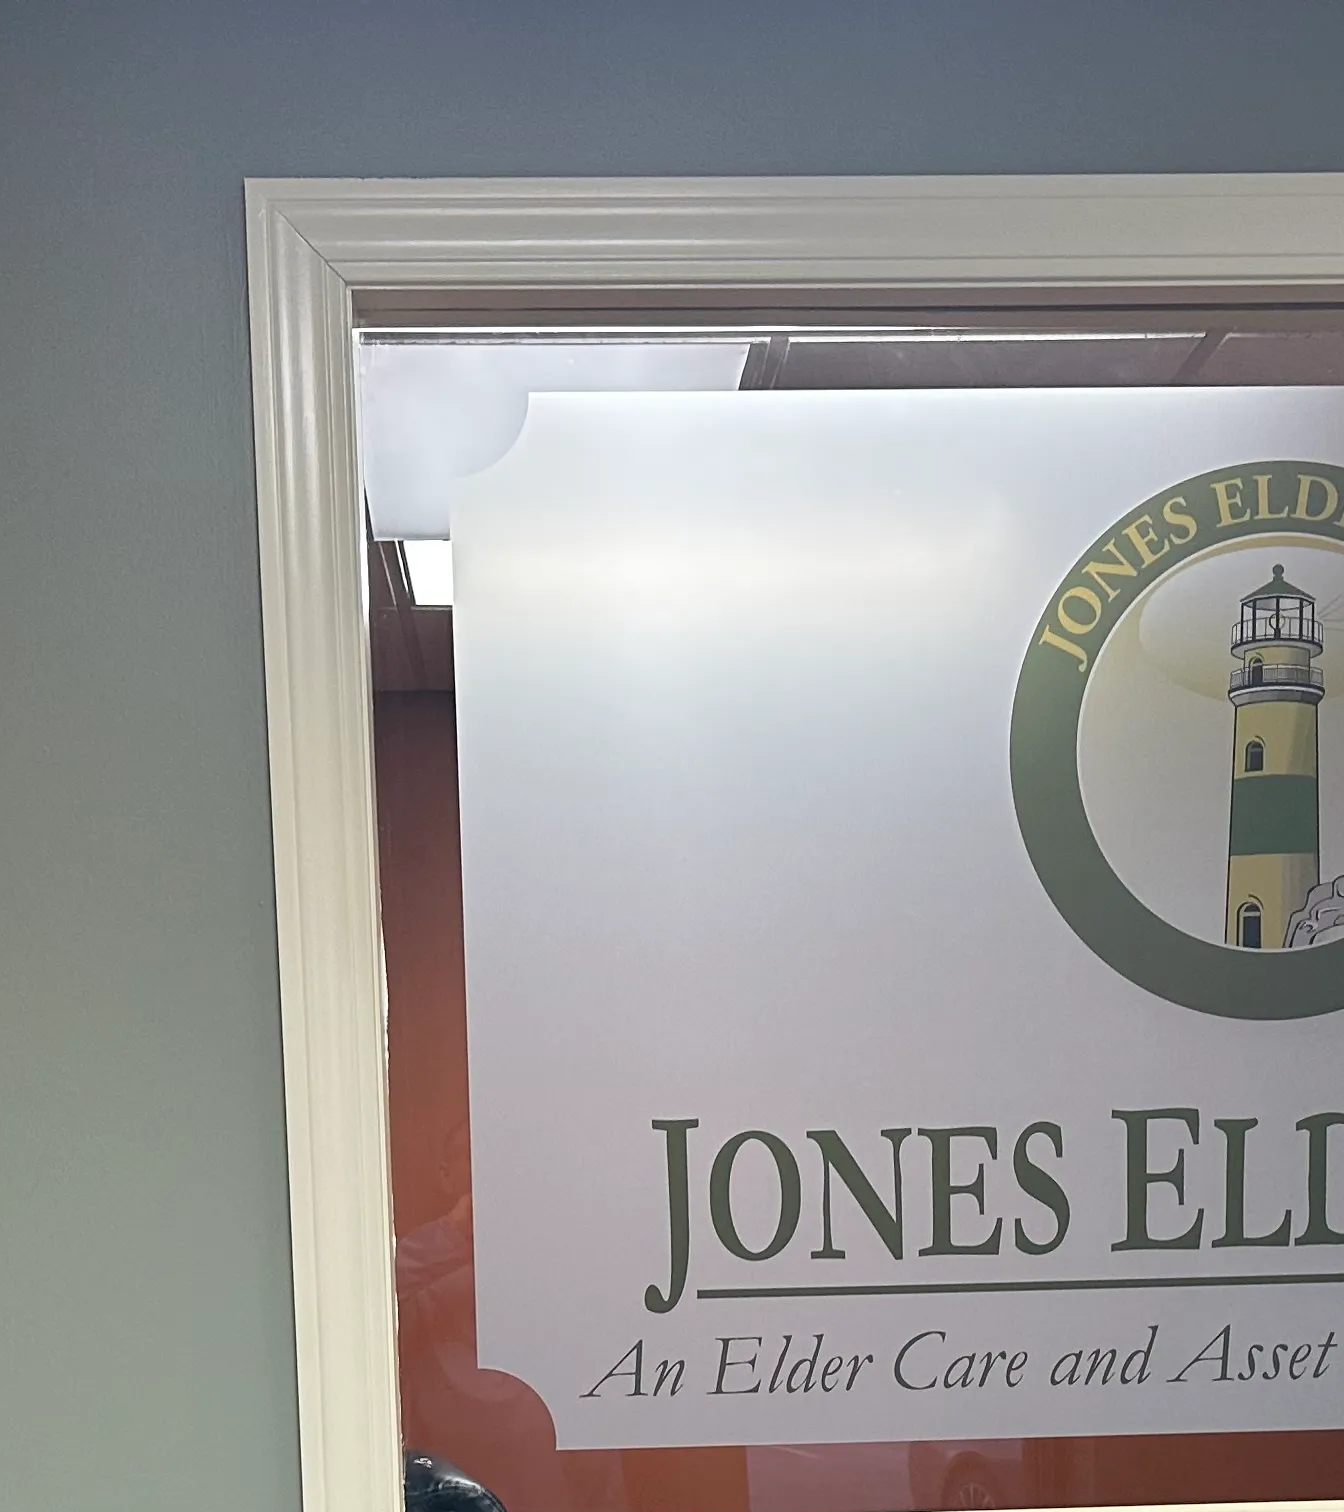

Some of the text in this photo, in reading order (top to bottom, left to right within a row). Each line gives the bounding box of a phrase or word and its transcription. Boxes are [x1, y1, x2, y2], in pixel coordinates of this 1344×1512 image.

[1037, 495, 1198, 673] JONES
[644, 1117, 1071, 1314] JONES
[579, 1338, 684, 1399] An
[706, 1333, 874, 1396] Elder
[892, 1330, 1026, 1391] Care
[1050, 1325, 1159, 1387] and
[1167, 1323, 1338, 1383] Asset
